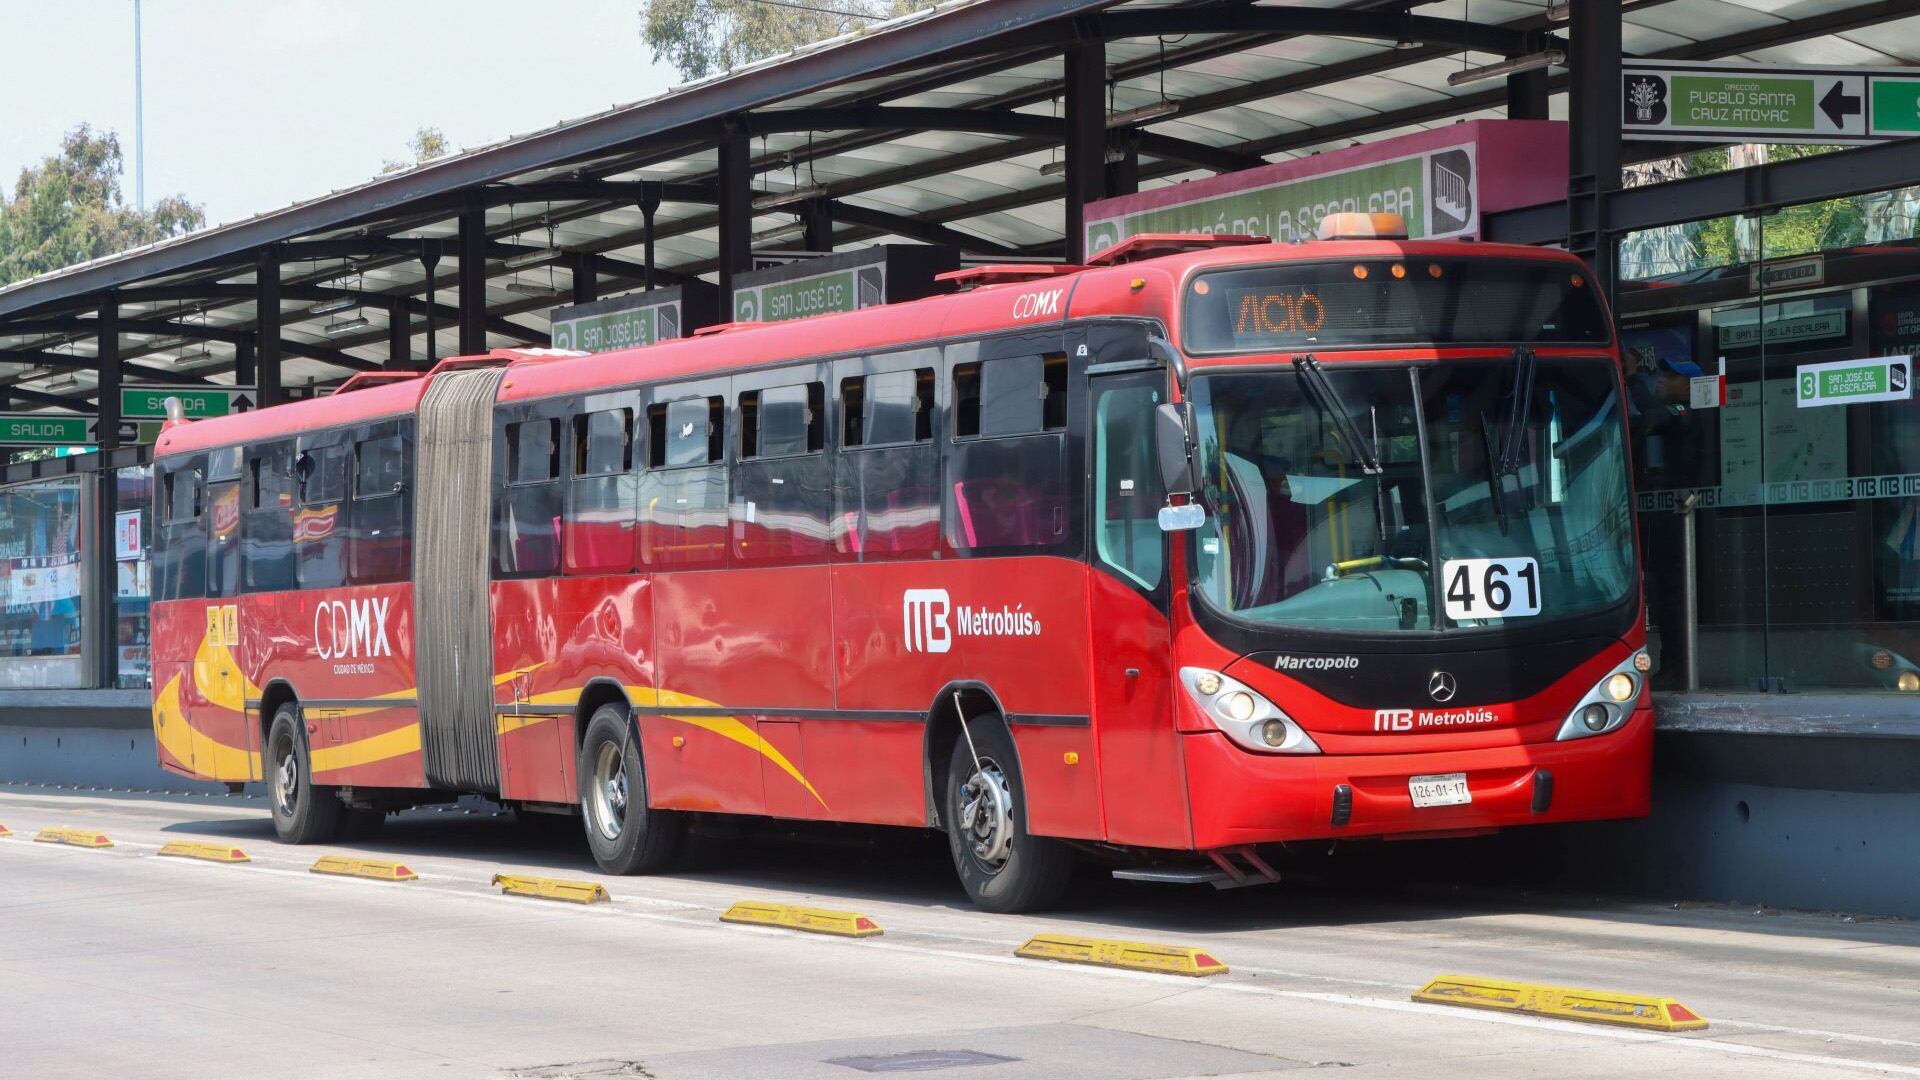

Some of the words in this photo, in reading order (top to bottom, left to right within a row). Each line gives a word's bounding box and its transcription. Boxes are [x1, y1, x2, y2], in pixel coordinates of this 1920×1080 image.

[1689, 91, 1745, 105] PUEBLO
[1748, 92, 1796, 107] SANTA
[1691, 107, 1729, 121] CRUZ
[1732, 109, 1790, 122] ATOYAC
[771, 294, 793, 316] SAN
[795, 281, 825, 312] JOSÉ
[827, 285, 843, 307] DE
[1013, 289, 1064, 319] CDMX
[584, 327, 603, 348] SAN
[605, 315, 631, 344] JOSÉ
[633, 319, 647, 340] DE
[1828, 375, 1843, 384] SAN
[1844, 370, 1864, 383] JOSÉ
[1864, 371, 1875, 381] DE
[1803, 376, 1813, 395] 3
[1829, 385, 1839, 394] LA
[1839, 381, 1877, 393] ESCALERA
[11, 424, 65, 436] SALIDA
[1447, 562, 1537, 612] 461
[314, 597, 391, 660] CDMX
[1274, 655, 1360, 671] Marcopolo
[1413, 782, 1465, 798] 126-01-17
